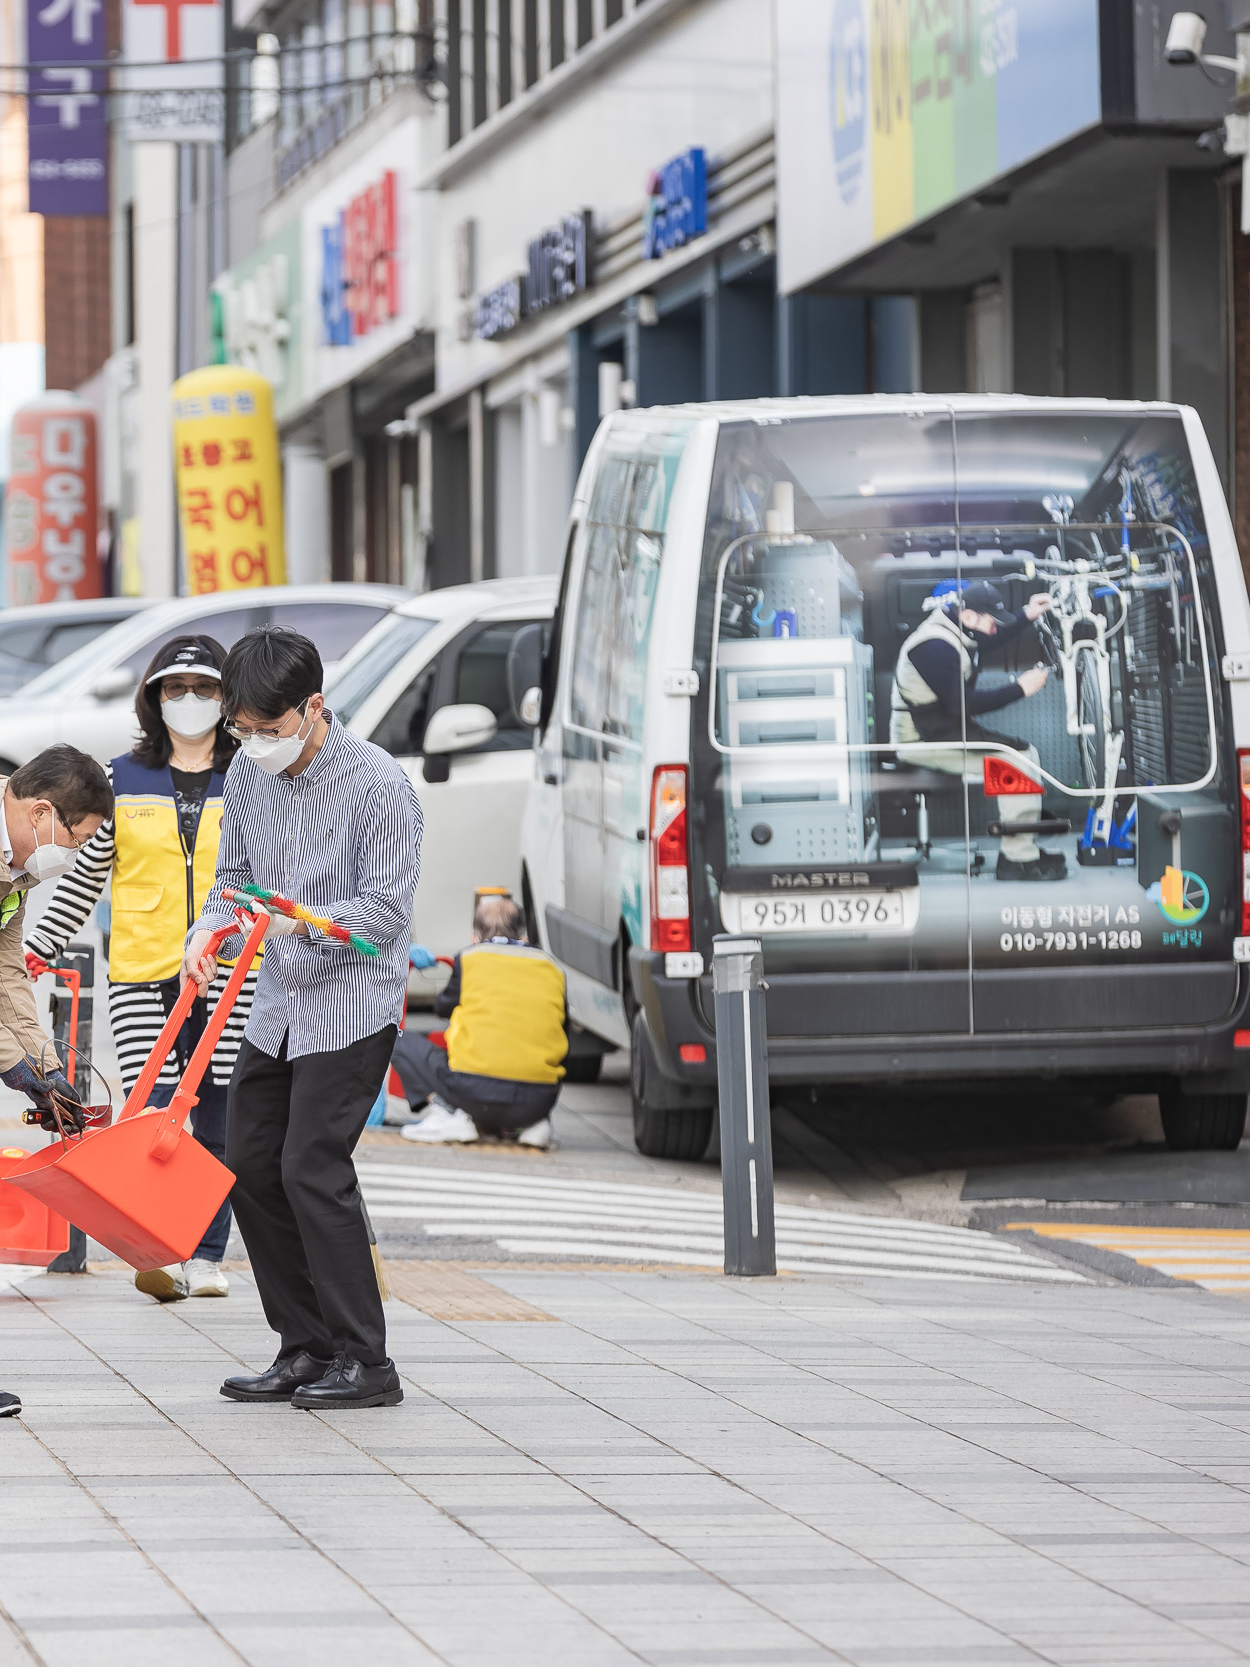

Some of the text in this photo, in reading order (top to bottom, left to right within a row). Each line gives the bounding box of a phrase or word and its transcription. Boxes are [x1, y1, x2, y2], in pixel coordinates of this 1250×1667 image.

[771, 872, 871, 888] MASTER
[753, 898, 889, 927] 95거 0396
[1001, 903, 1140, 929] 이동형 자전거 AS
[1000, 929, 1143, 952] 010-7931-1268
